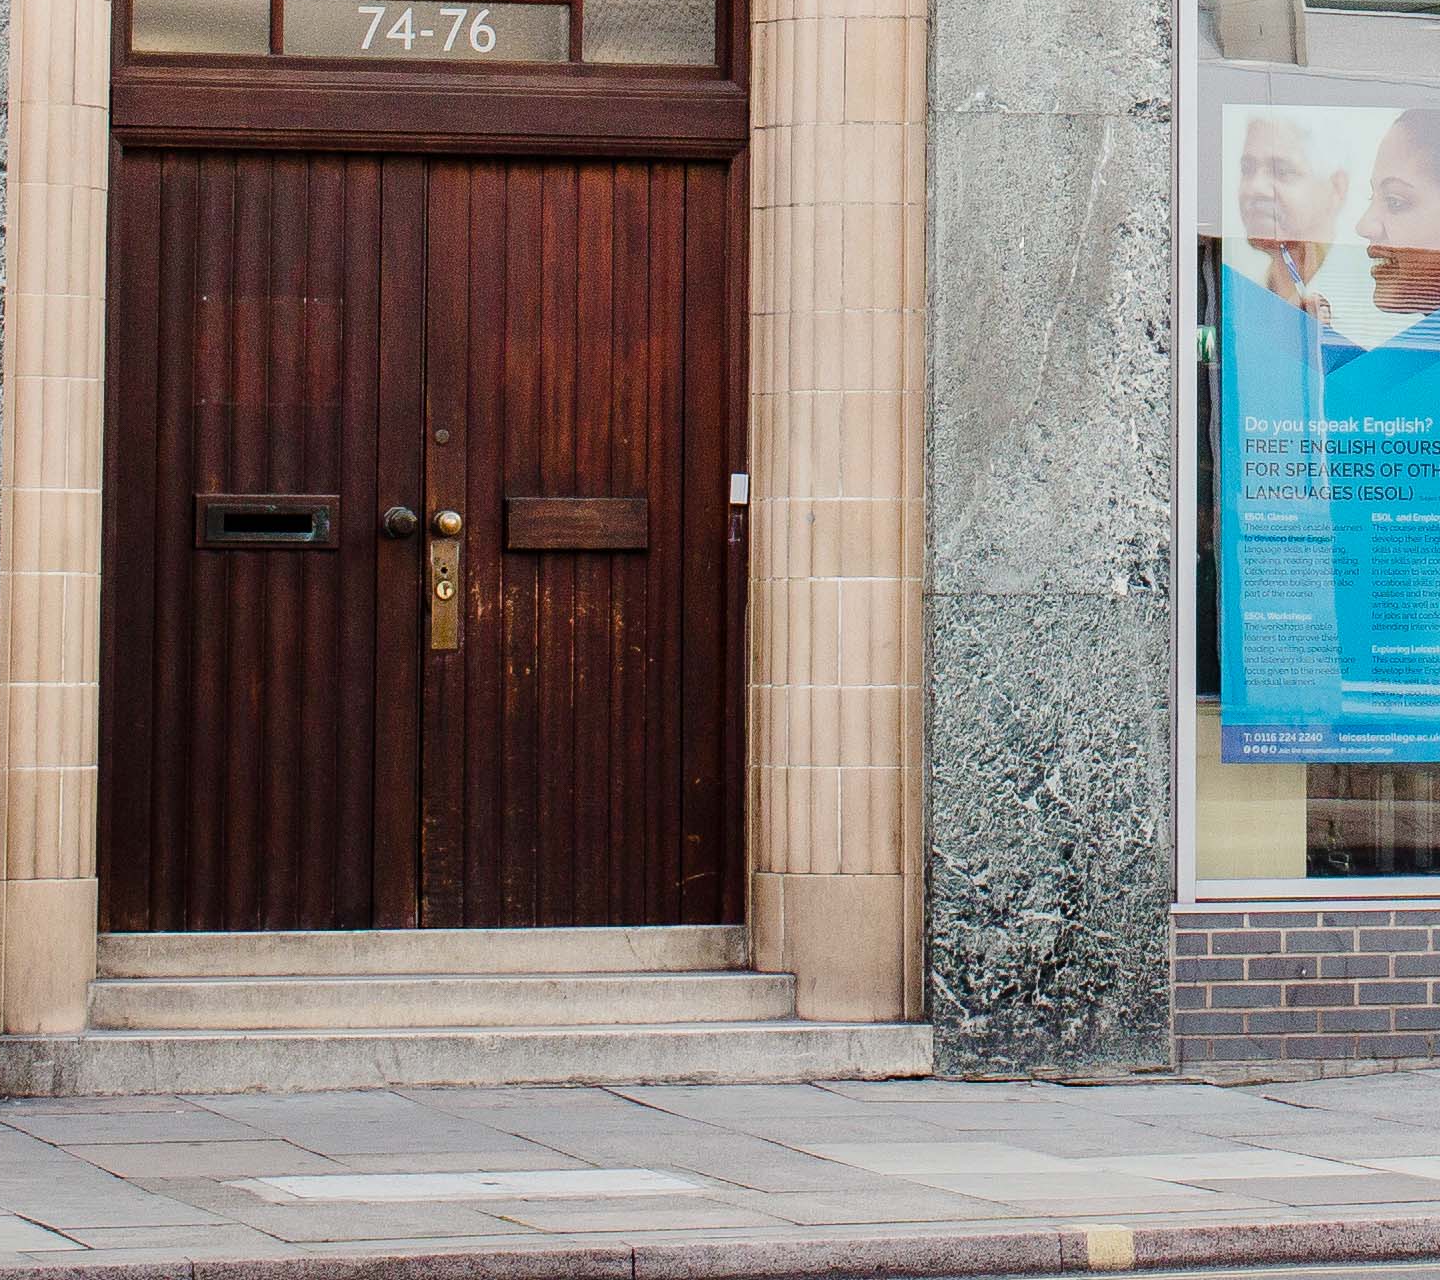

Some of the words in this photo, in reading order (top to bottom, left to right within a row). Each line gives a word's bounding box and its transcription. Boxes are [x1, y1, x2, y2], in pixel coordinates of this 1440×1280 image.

[358, 5, 496, 54] 74-76
[1245, 417, 1268, 433] Do
[1273, 418, 1303, 436] you
[1309, 416, 1358, 436] speak
[1363, 417, 1433, 436] English?
[1300, 440, 1375, 454] ENGLISH
[1246, 463, 1279, 477] FOR
[1285, 463, 1375, 477] SPEAKERS
[1380, 463, 1403, 477] OF
[1246, 485, 1352, 500] LANGUAGES
[1358, 485, 1413, 501] (ESOL)
